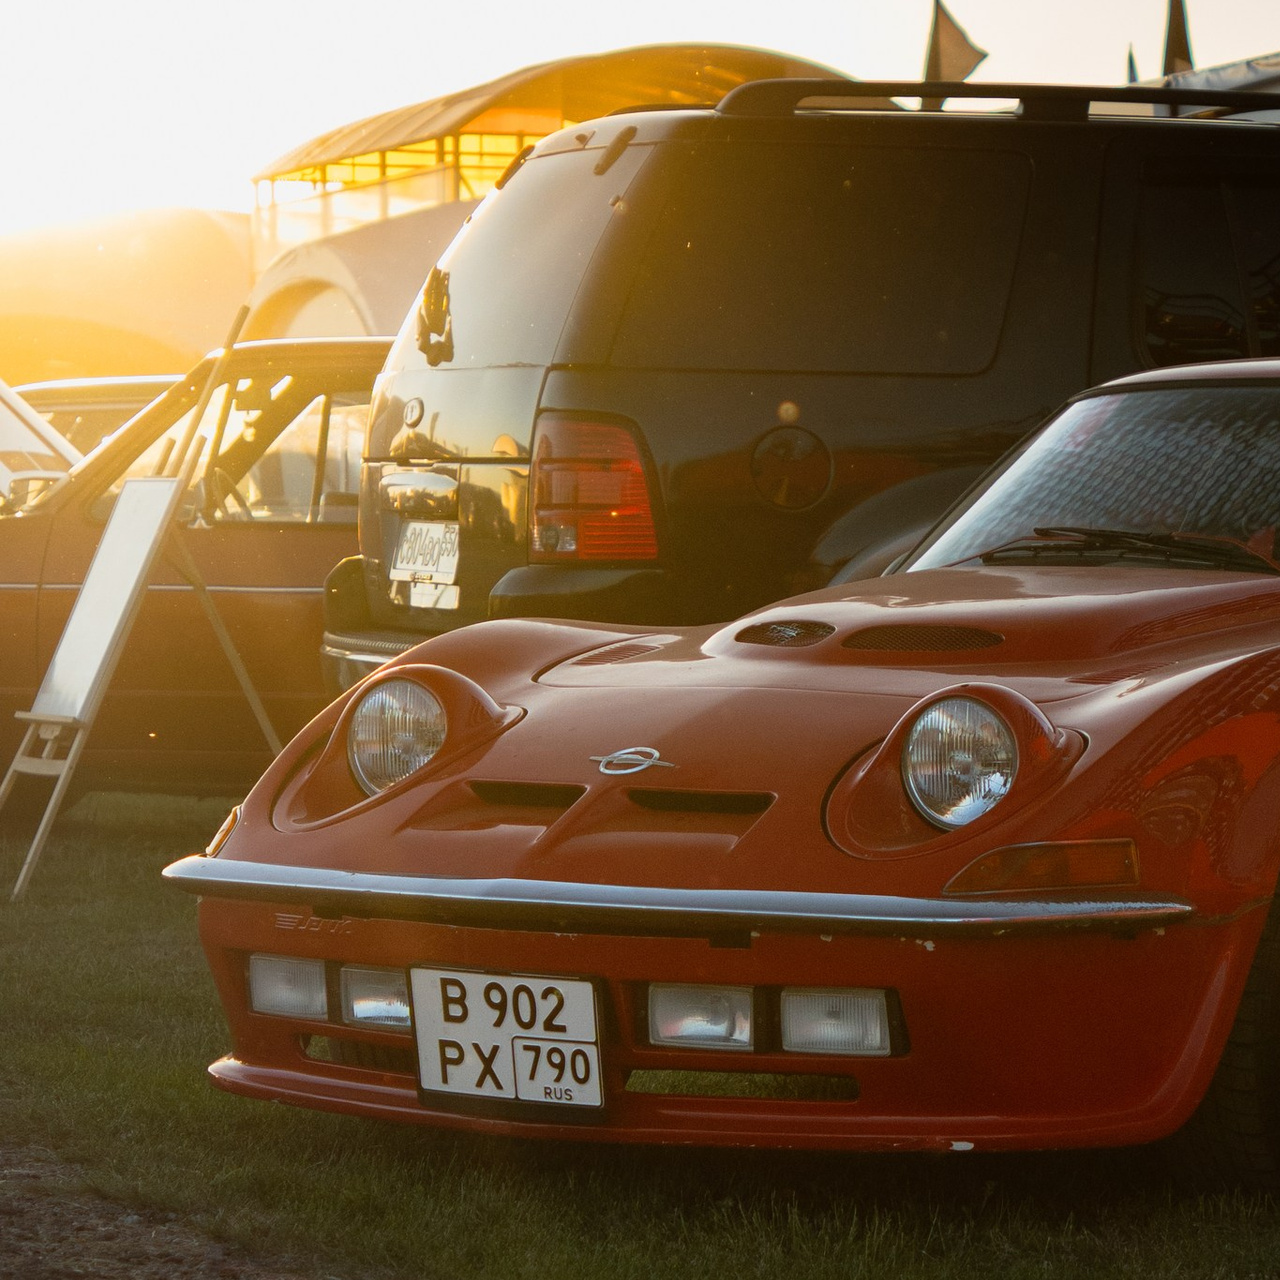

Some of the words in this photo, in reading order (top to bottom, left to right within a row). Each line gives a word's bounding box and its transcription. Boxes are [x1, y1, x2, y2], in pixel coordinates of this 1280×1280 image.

[440, 977, 469, 1024] B
[483, 981, 567, 1033] 902
[438, 1039, 504, 1091] PX
[522, 1044, 590, 1085] 790
[543, 1086, 573, 1101] RUS
